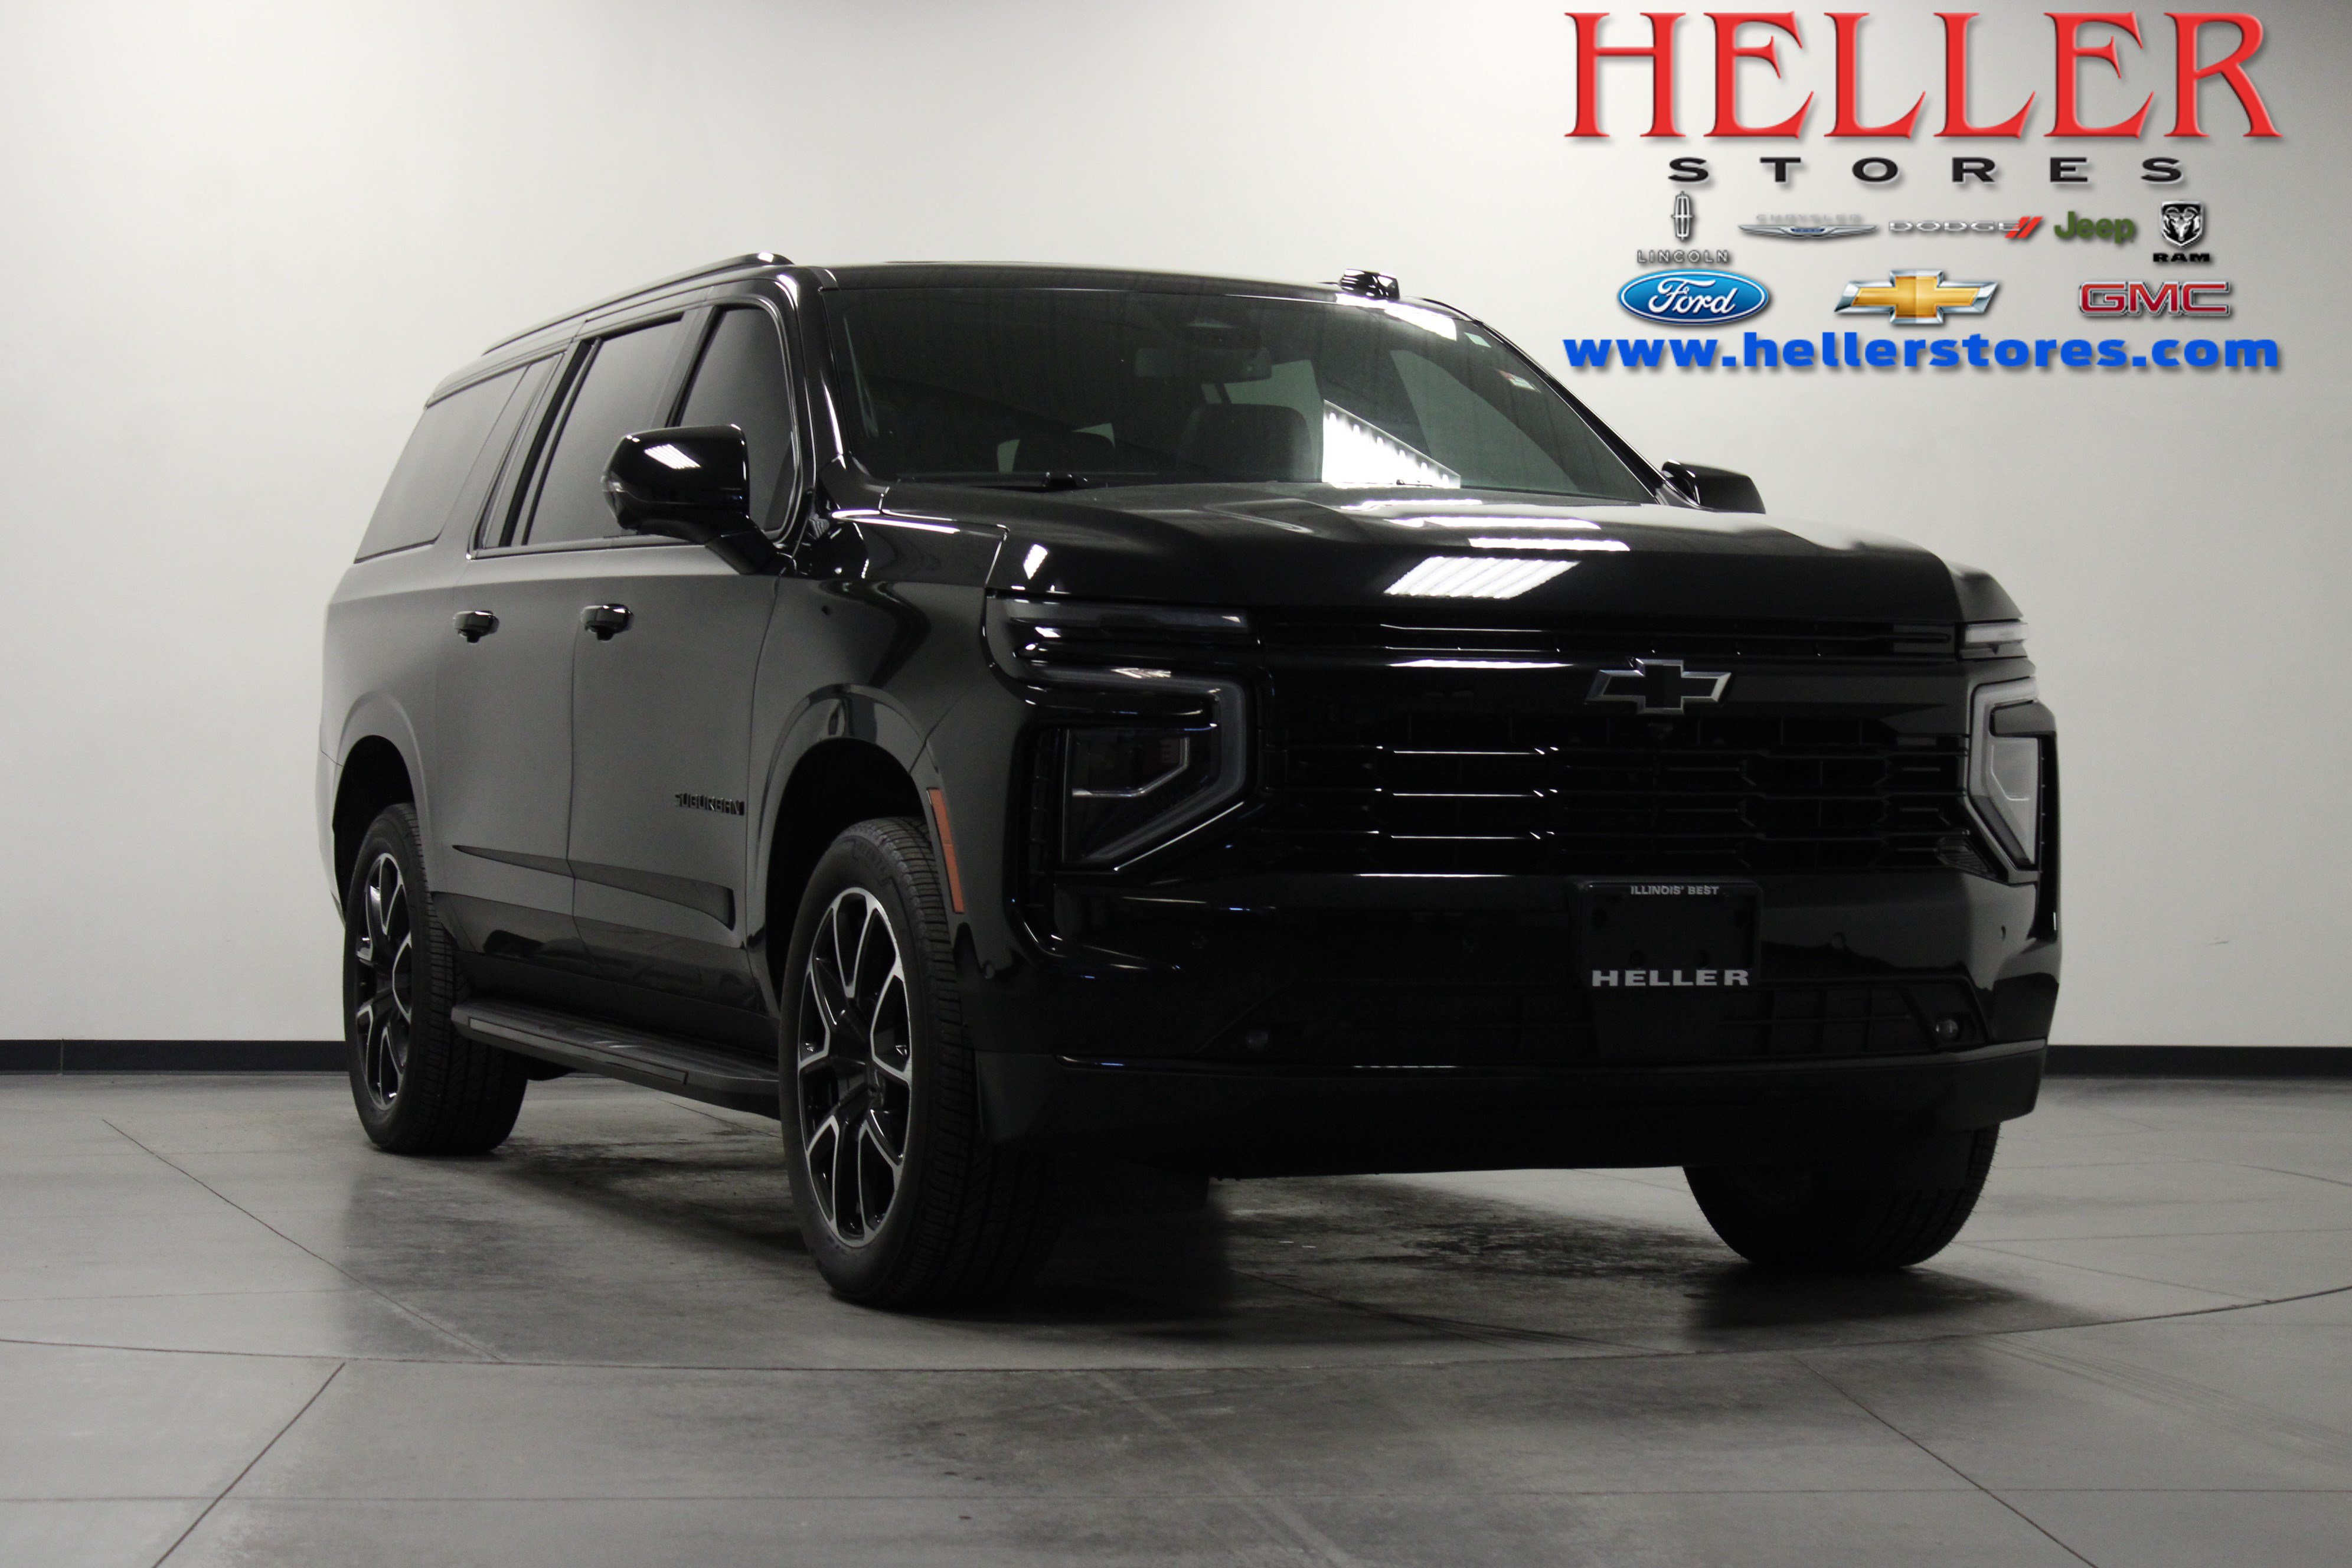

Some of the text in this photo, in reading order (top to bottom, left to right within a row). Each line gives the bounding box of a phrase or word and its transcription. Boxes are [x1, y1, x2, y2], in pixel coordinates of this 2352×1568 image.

[675, 793, 744, 816] SUBURBAN
[1688, 885, 1719, 895] BEST
[1592, 969, 1749, 986] HELLER
